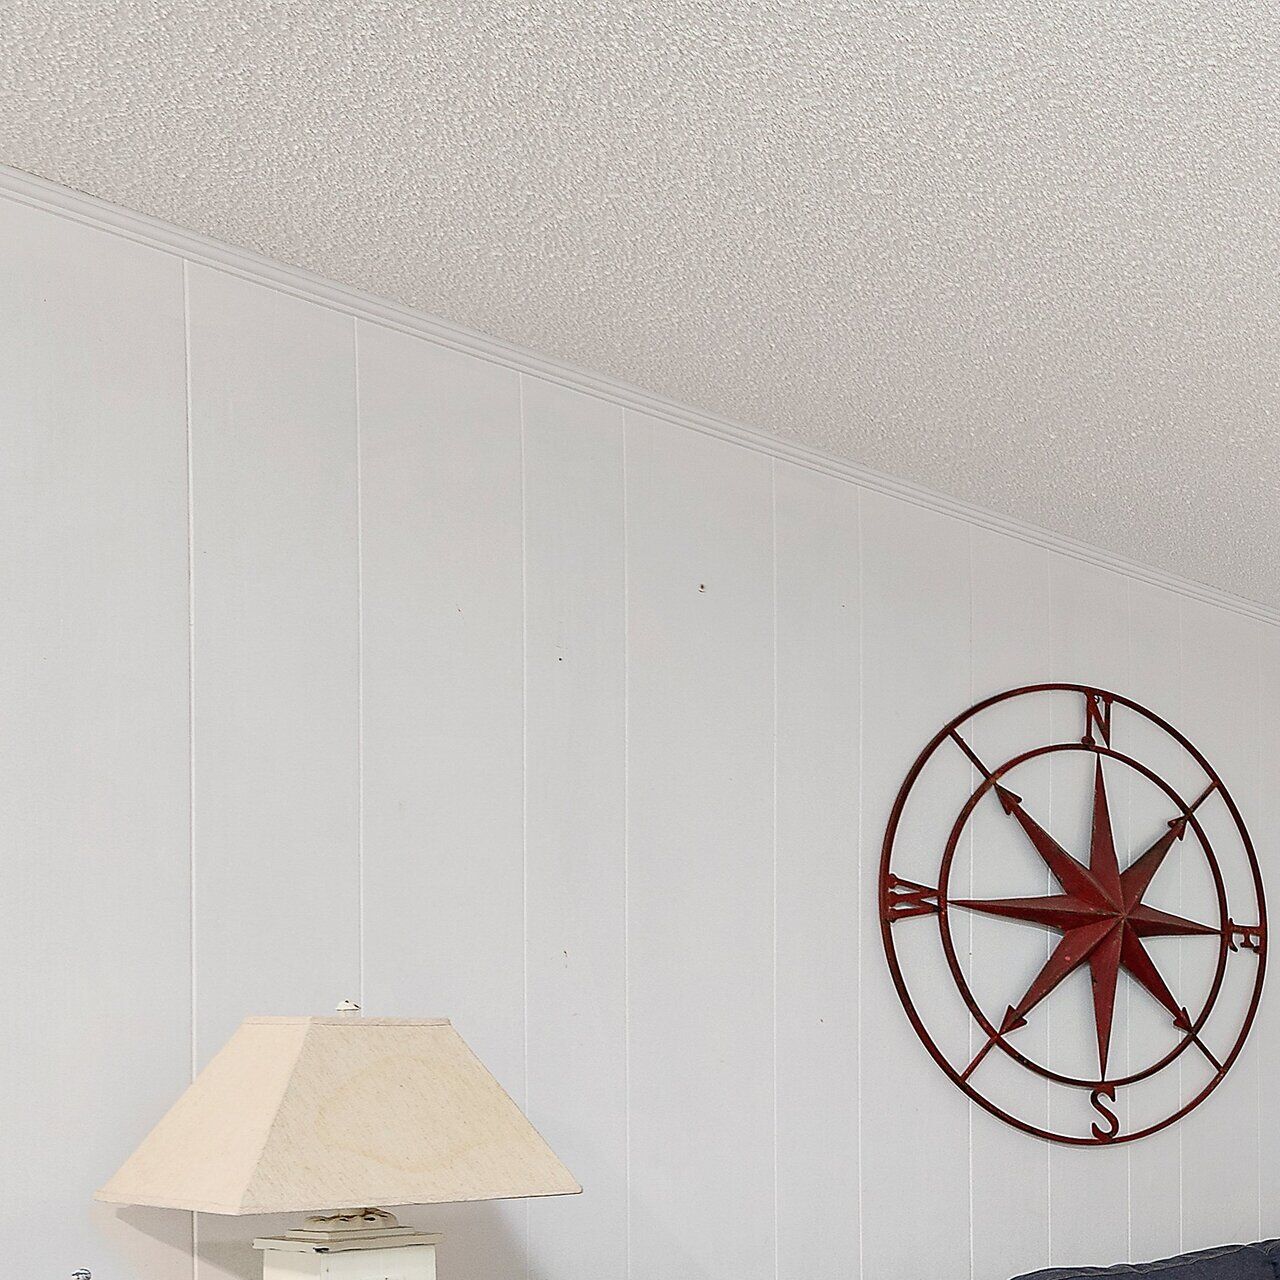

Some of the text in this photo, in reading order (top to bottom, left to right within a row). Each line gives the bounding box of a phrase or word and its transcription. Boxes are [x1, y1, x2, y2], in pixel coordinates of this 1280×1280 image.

[1081, 688, 1114, 749] N
[887, 874, 941, 923] W
[1225, 917, 1263, 955] E
[1090, 1084, 1120, 1141] S
